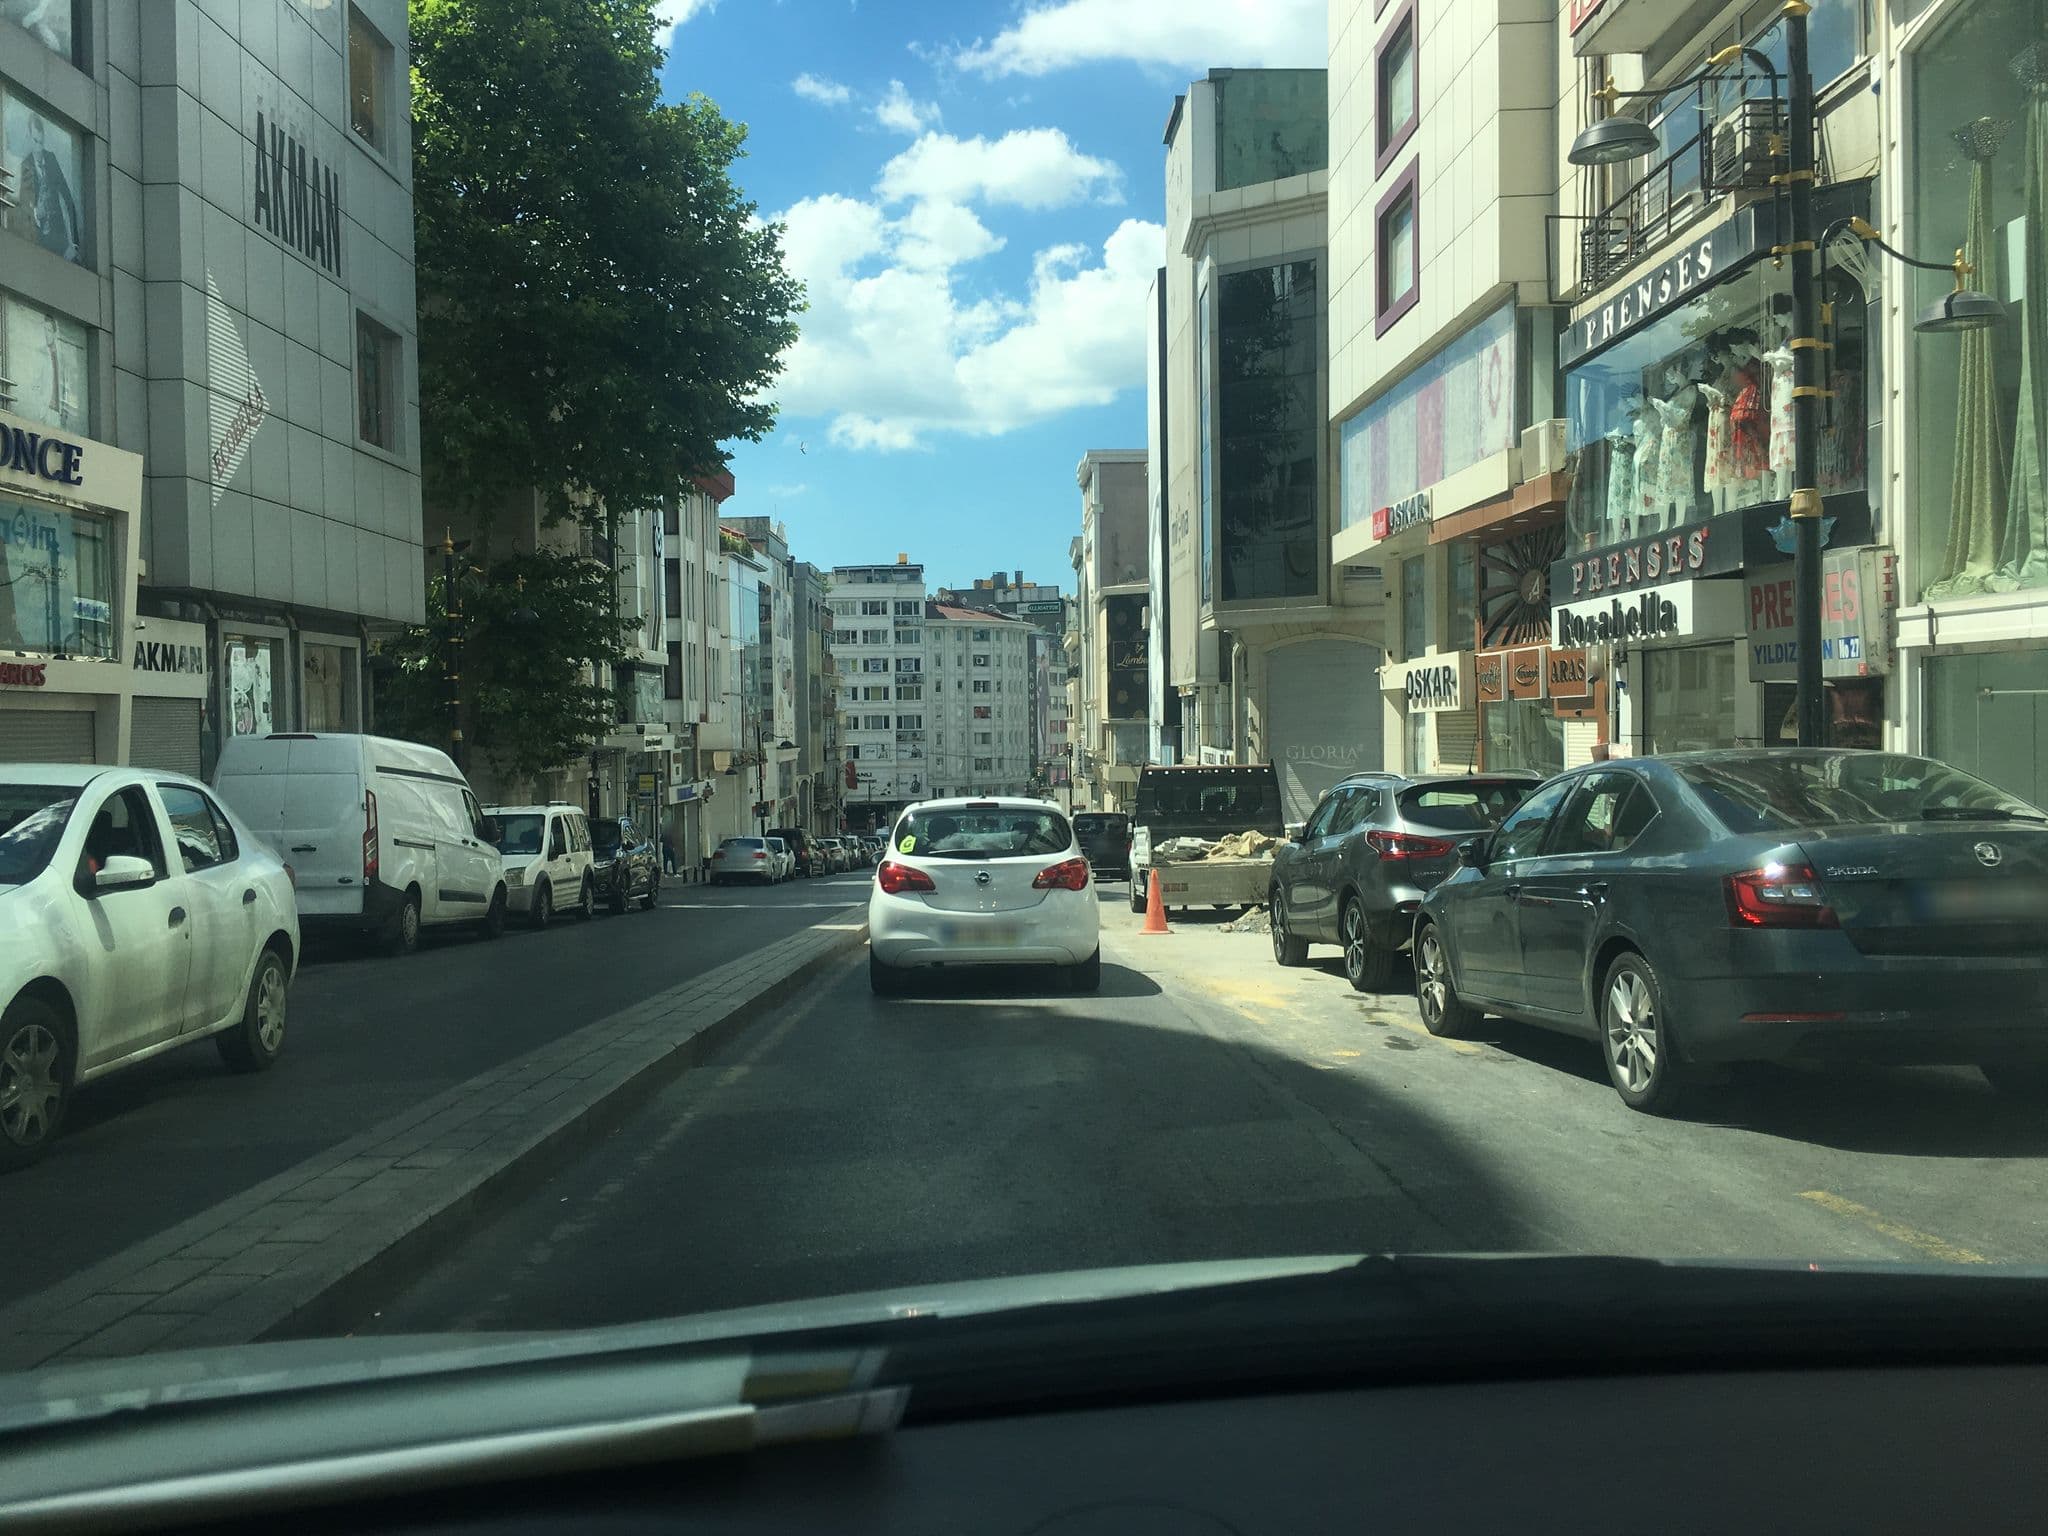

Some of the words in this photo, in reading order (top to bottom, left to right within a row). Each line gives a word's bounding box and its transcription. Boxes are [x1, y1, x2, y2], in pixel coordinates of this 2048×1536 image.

[255, 111, 341, 277] AKMAN
[1586, 241, 1712, 349] PRENSES
[1389, 493, 1427, 529] OSKAR
[1572, 531, 1705, 594] PRENSES
[1751, 569, 1859, 631] PREES
[134, 641, 203, 674] AKMAN
[1551, 658, 1585, 683] ARAS
[1754, 642, 1797, 665] YILDIZ
[1406, 665, 1454, 699] OSKAR
[1285, 745, 1360, 760] GLORIA
